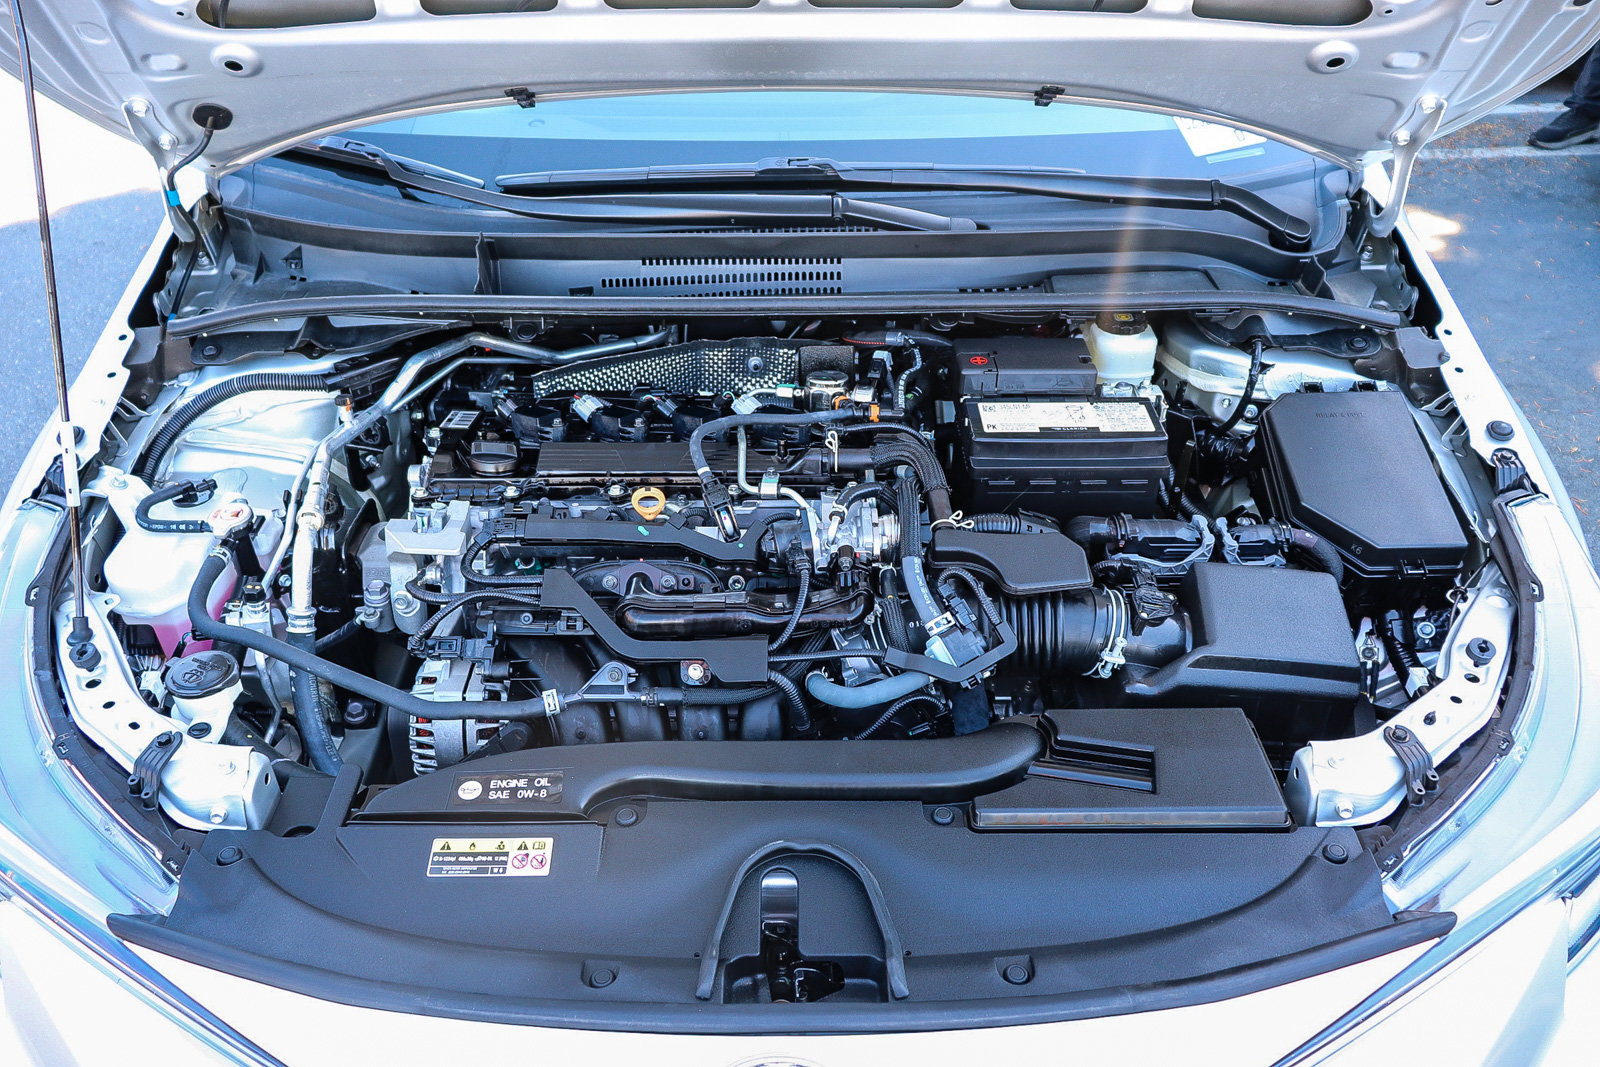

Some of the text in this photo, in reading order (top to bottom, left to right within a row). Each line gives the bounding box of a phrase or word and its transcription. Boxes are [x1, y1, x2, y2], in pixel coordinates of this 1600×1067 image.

[986, 423, 998, 431] PK
[489, 777, 552, 789] ENGINE OIL
[488, 789, 548, 800] SAE 0W-8
